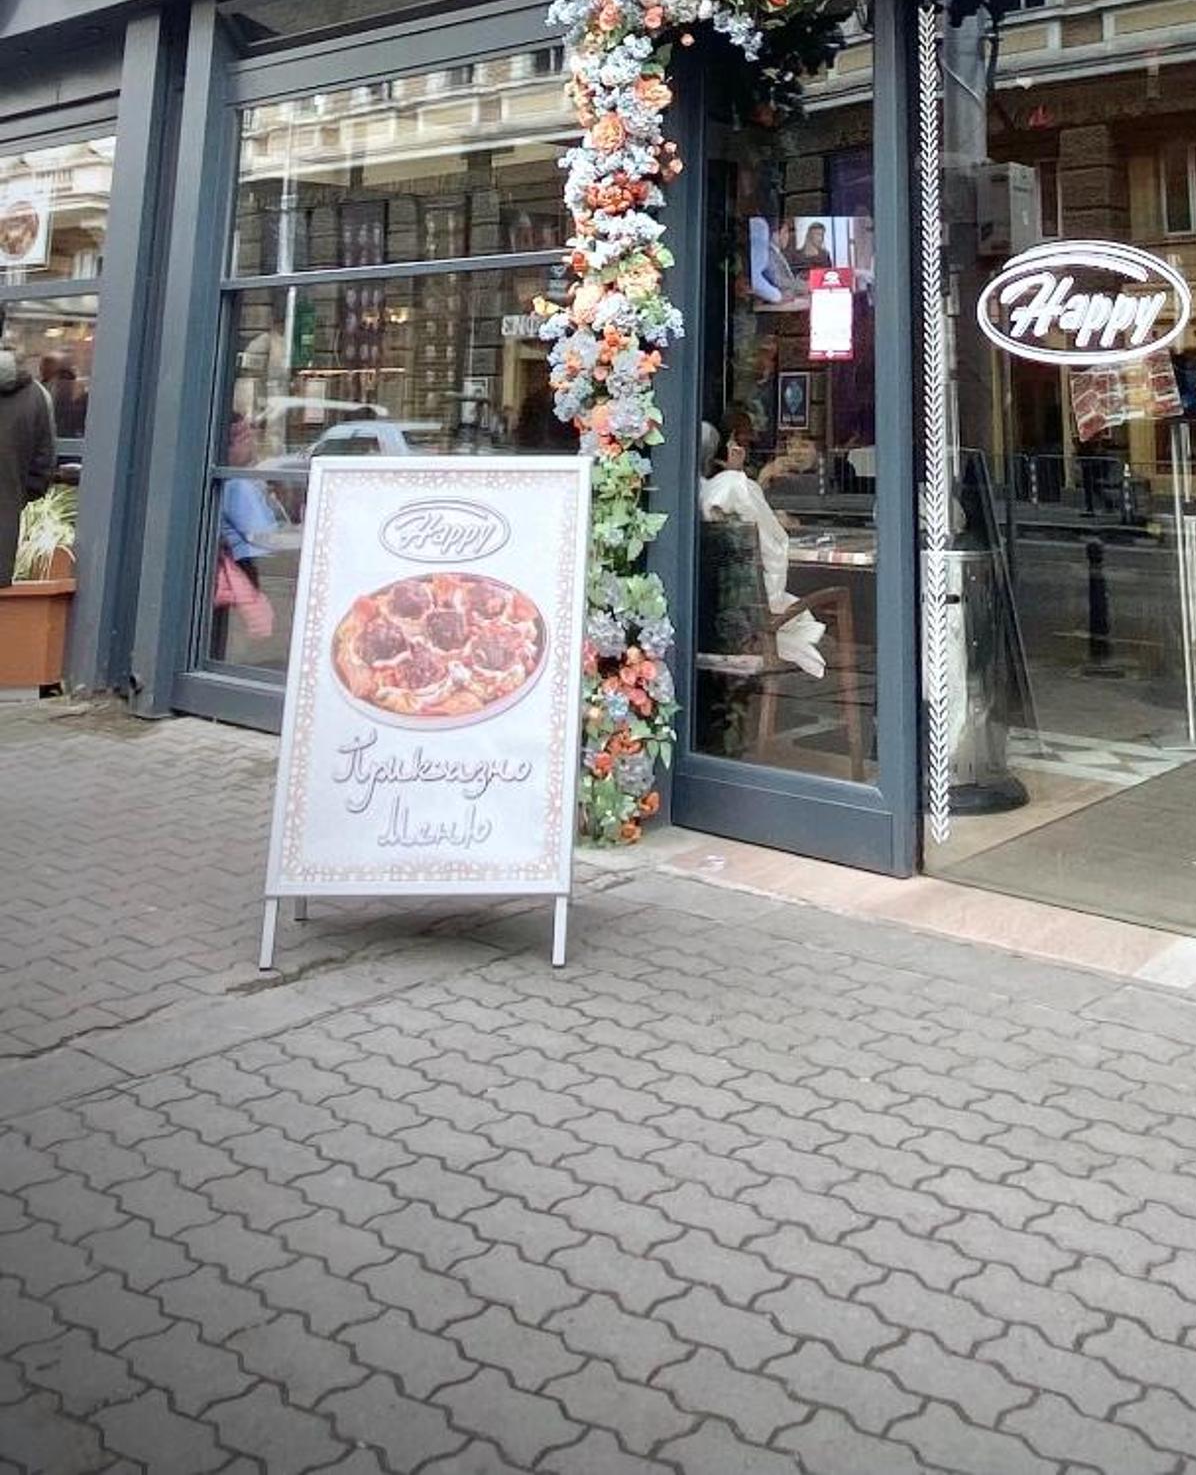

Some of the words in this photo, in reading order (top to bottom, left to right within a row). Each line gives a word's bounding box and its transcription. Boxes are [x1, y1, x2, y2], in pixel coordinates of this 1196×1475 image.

[1000, 271, 1167, 348] Happy
[396, 506, 497, 555] Happy
[377, 794, 493, 849] Меню
